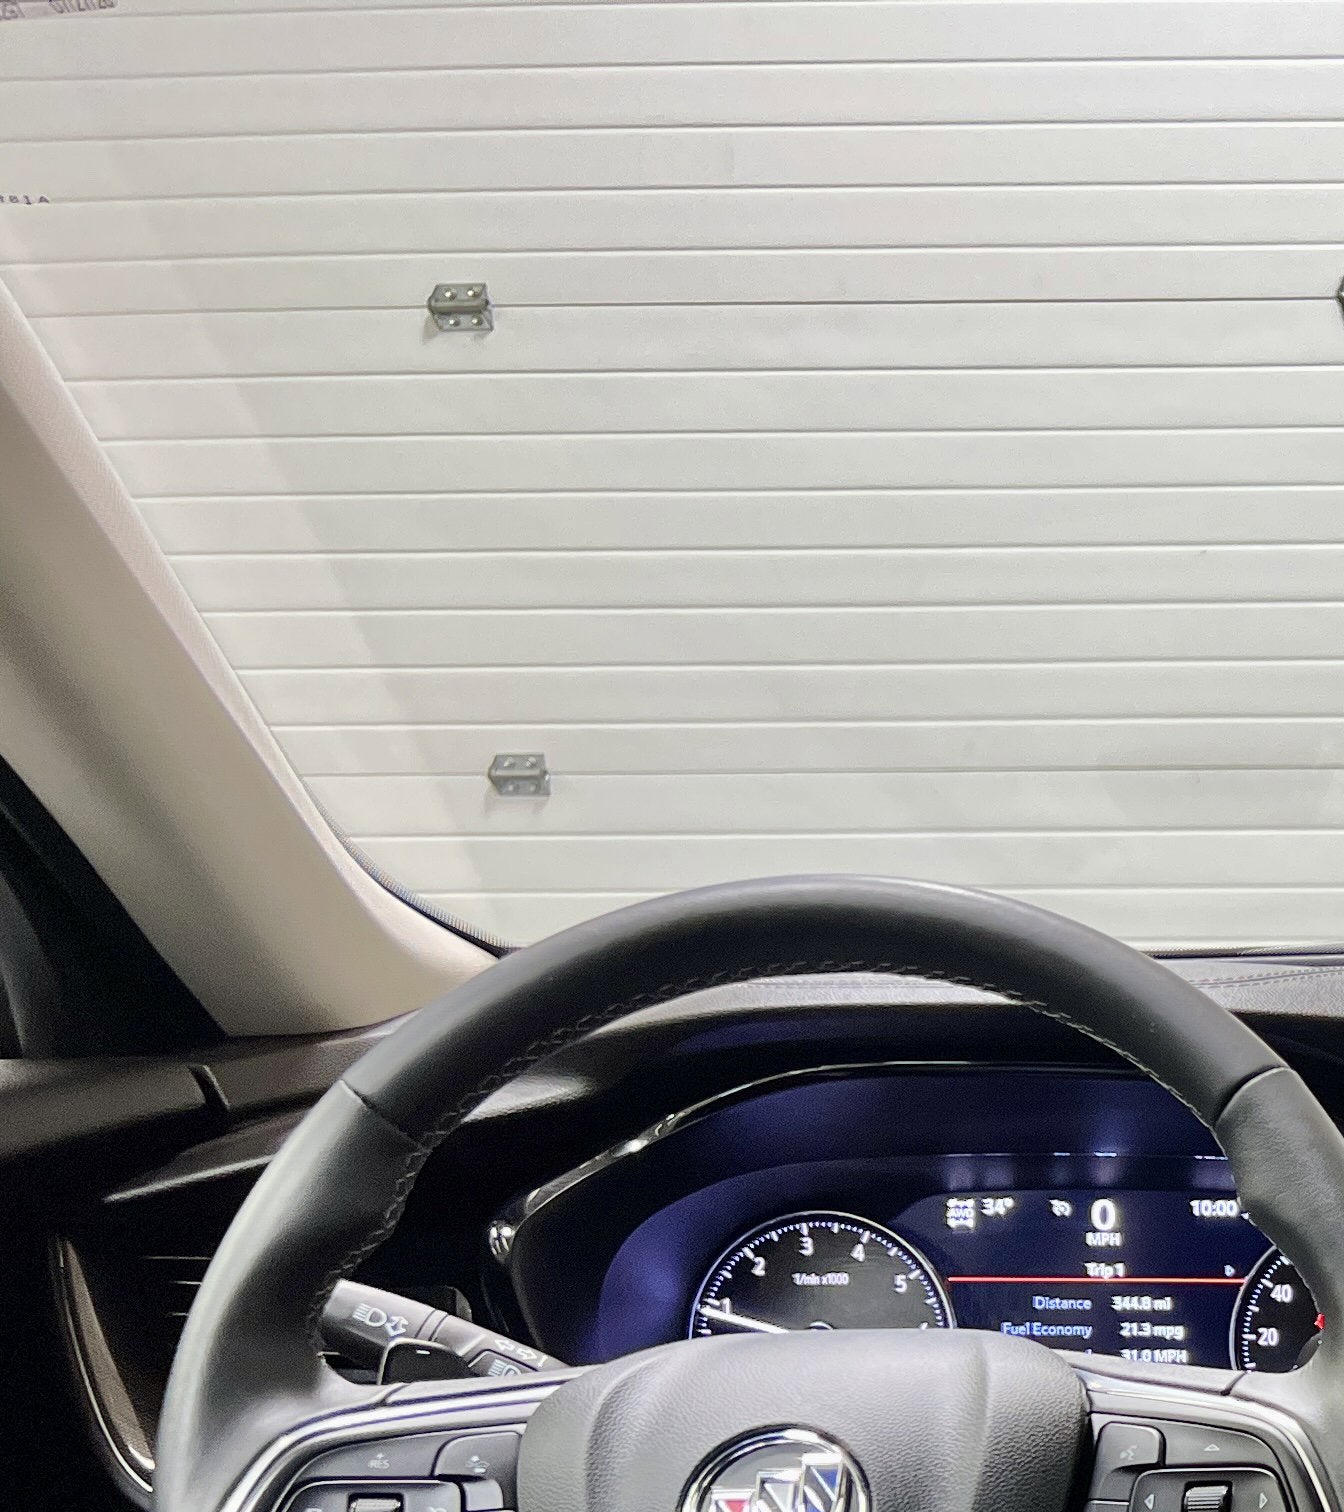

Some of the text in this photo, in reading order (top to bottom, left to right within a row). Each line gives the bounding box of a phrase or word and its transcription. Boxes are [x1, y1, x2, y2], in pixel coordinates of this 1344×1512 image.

[1090, 1198, 1117, 1231] 0
[1190, 1199, 1238, 1217] 10:00
[800, 1237, 813, 1256] 3
[1086, 1231, 1121, 1247] MPH
[851, 1243, 865, 1262] 4
[751, 1256, 765, 1276] 2
[1084, 1261, 1126, 1279] Trip 1
[821, 1271, 849, 1286] x1000
[894, 1274, 907, 1293] 5
[1032, 1295, 1173, 1311] Distance 344.8 mi
[1270, 1284, 1293, 1303] 40
[722, 1298, 731, 1314] 1
[1001, 1321, 1185, 1341] Fuel Economy 21.3 mpg
[1257, 1327, 1279, 1347] 20
[1151, 1349, 1188, 1363] MPH
[368, 1457, 390, 1469] RES
